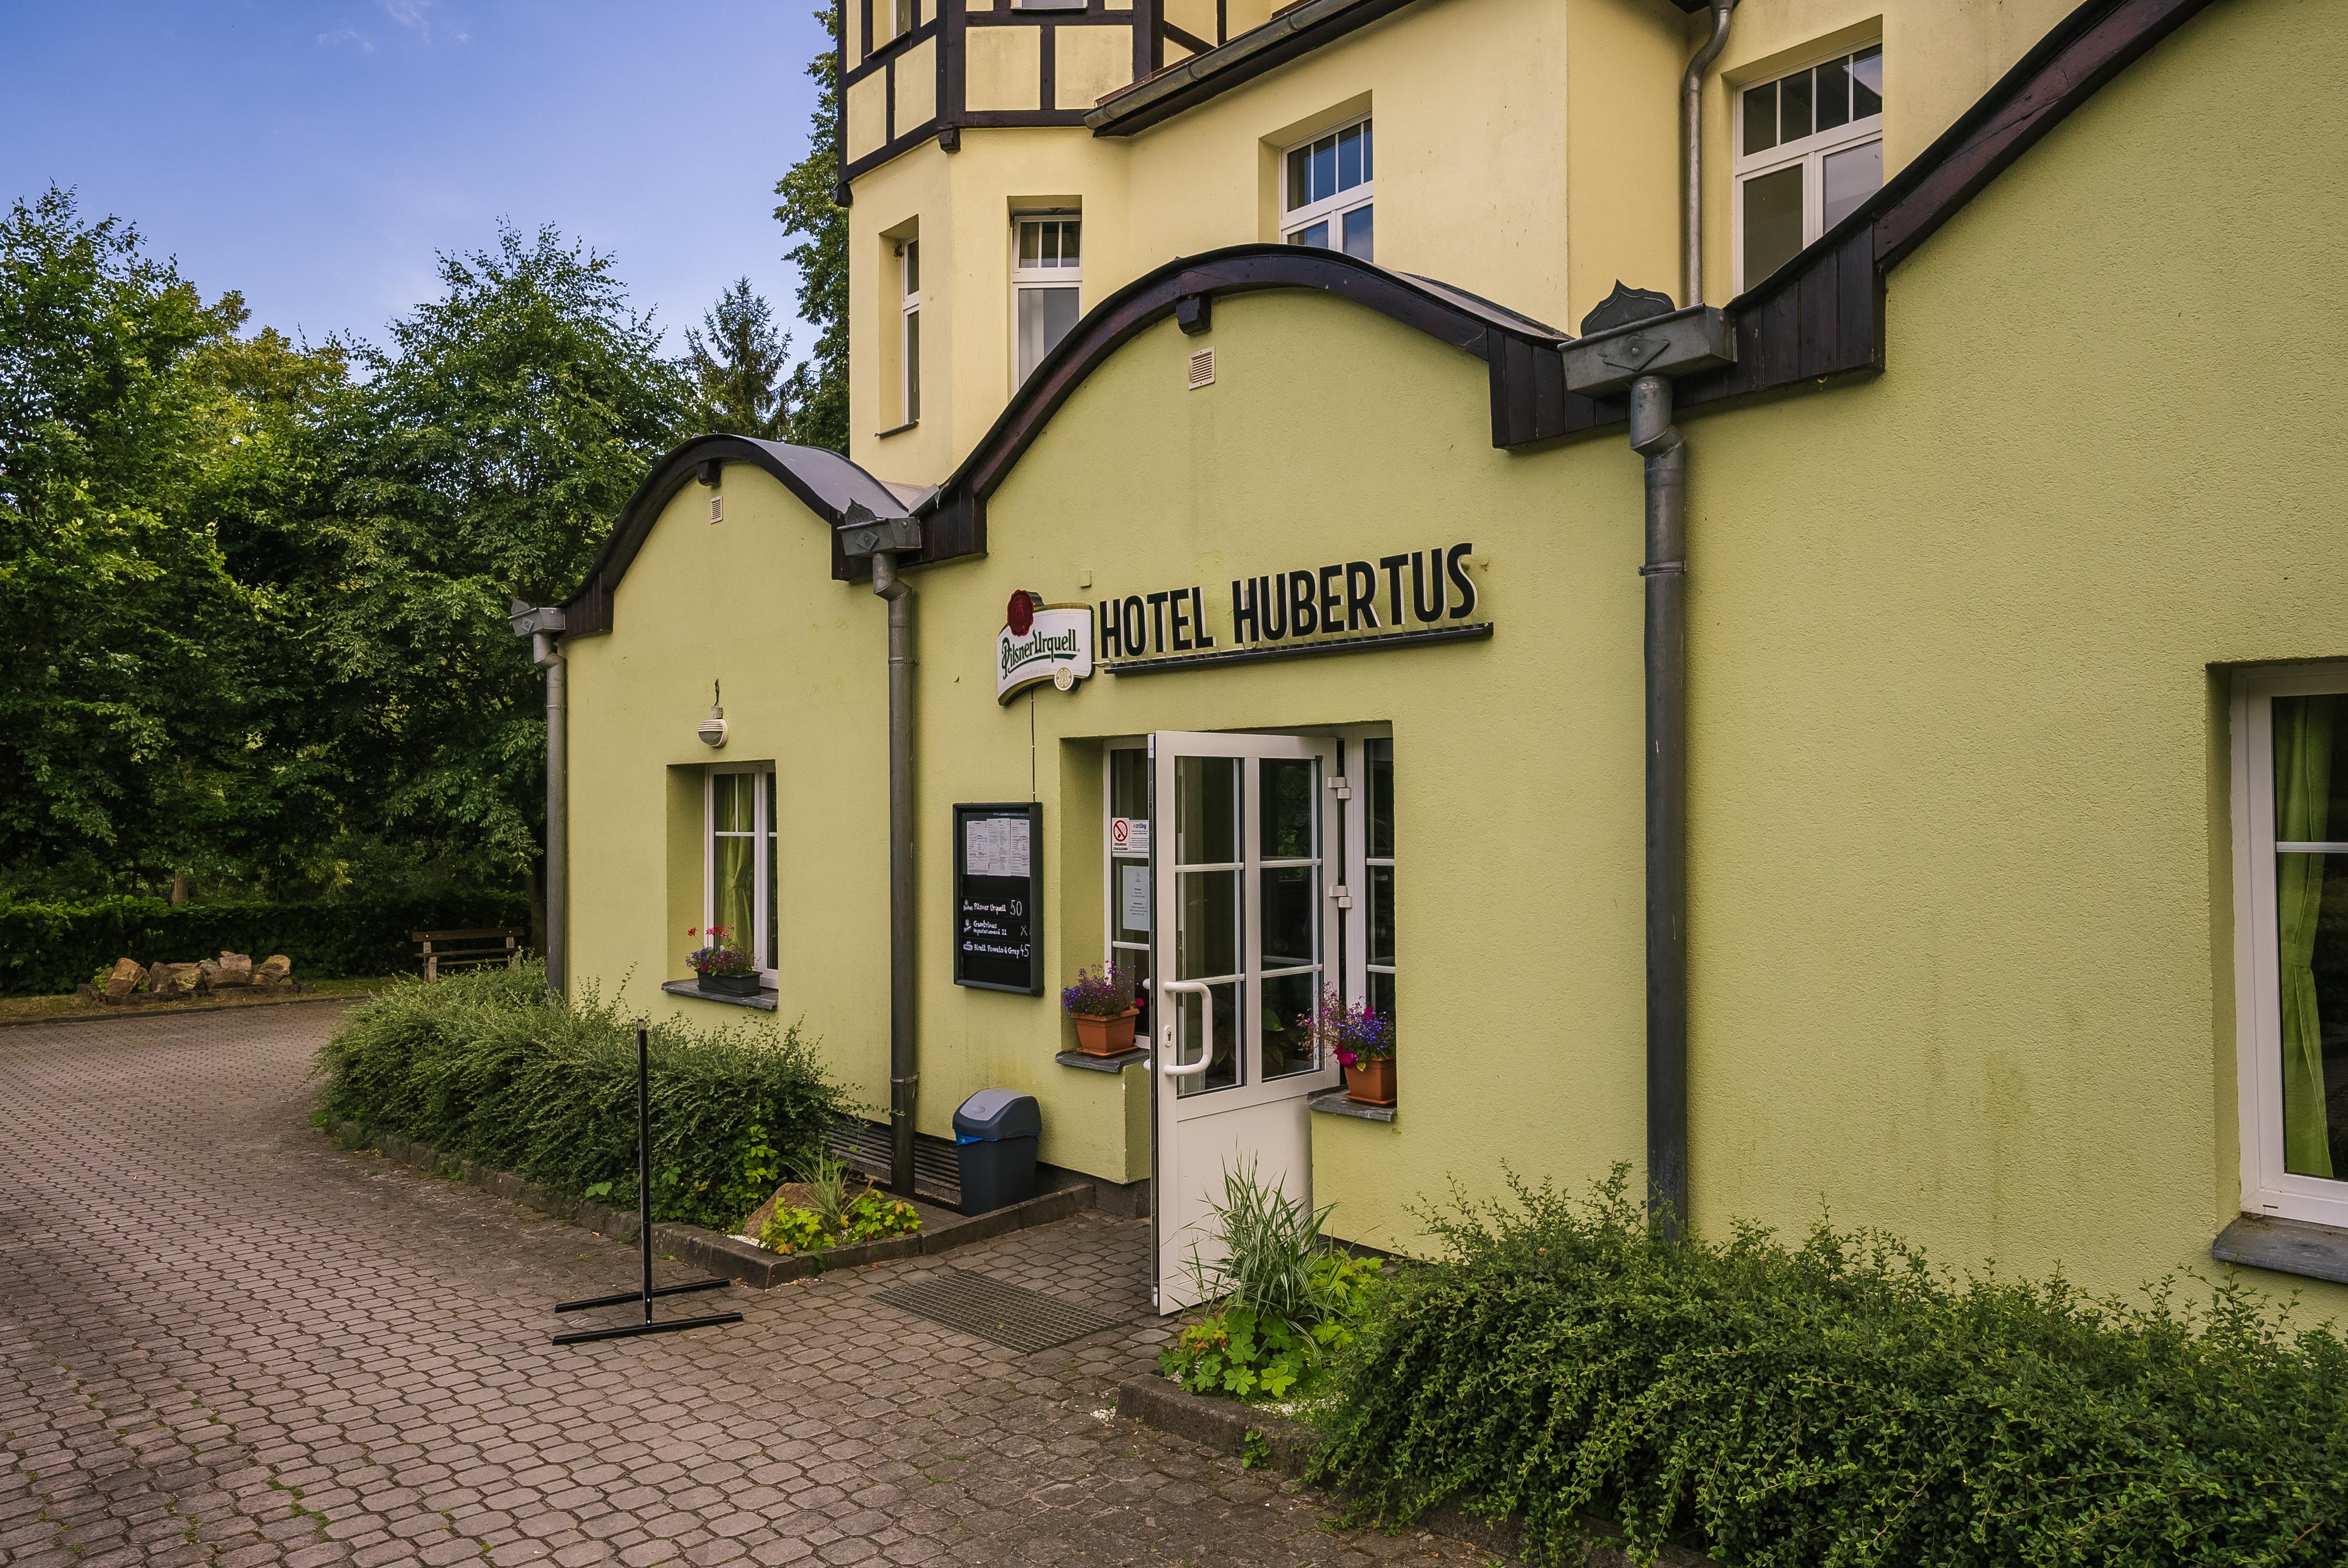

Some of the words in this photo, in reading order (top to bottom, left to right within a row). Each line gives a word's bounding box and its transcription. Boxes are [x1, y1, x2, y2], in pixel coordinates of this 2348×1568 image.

[1100, 586, 1216, 659] HOTEL
[1232, 542, 1479, 643] HUBERTUS
[1001, 637, 1034, 680] Pilsner
[1033, 628, 1077, 663] Urquell
[973, 902, 989, 911] Pilsner
[1010, 899, 1023, 916] 50
[973, 919, 997, 929] Gambrinus
[1020, 944, 1031, 957] 45
